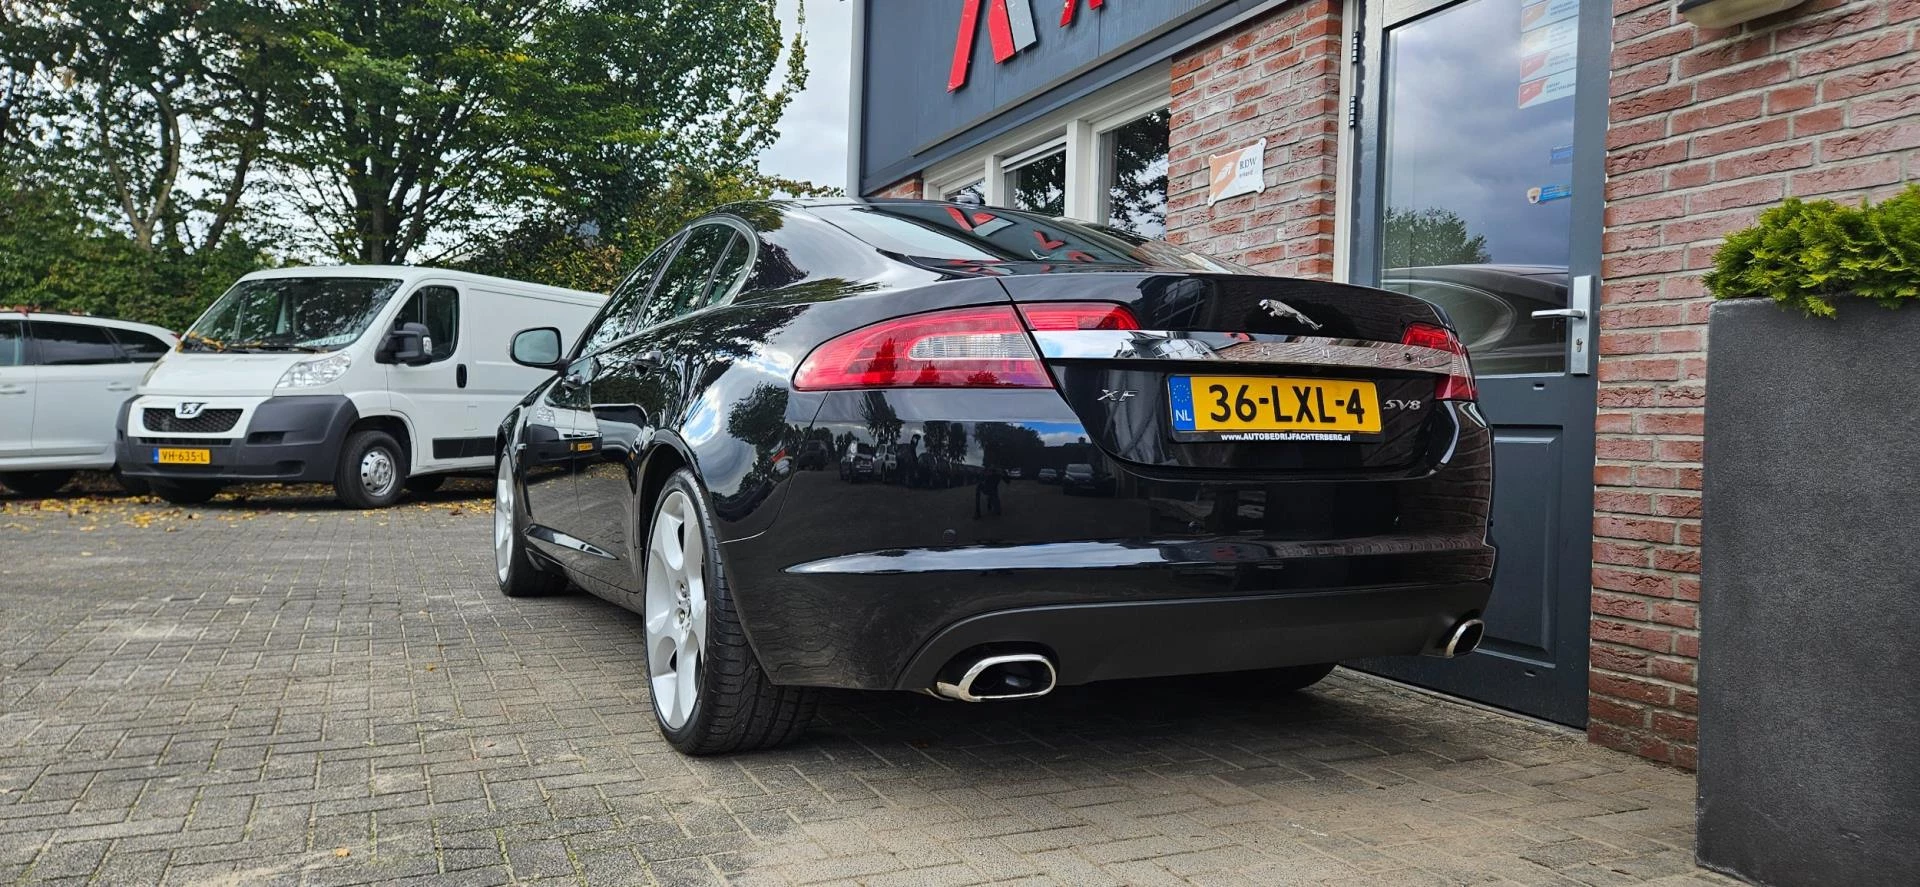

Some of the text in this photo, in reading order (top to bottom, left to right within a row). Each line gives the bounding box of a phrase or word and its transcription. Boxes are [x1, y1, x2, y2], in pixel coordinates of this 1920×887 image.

[1239, 156, 1257, 169] RDW
[1097, 389, 1139, 402] XF
[1209, 384, 1365, 424] 36-LXL-4
[1175, 409, 1192, 422] NL
[1221, 432, 1351, 442] www.AUTOBEDRIJFACHTERBERG.nl
[161, 450, 207, 462] VH-635-L
